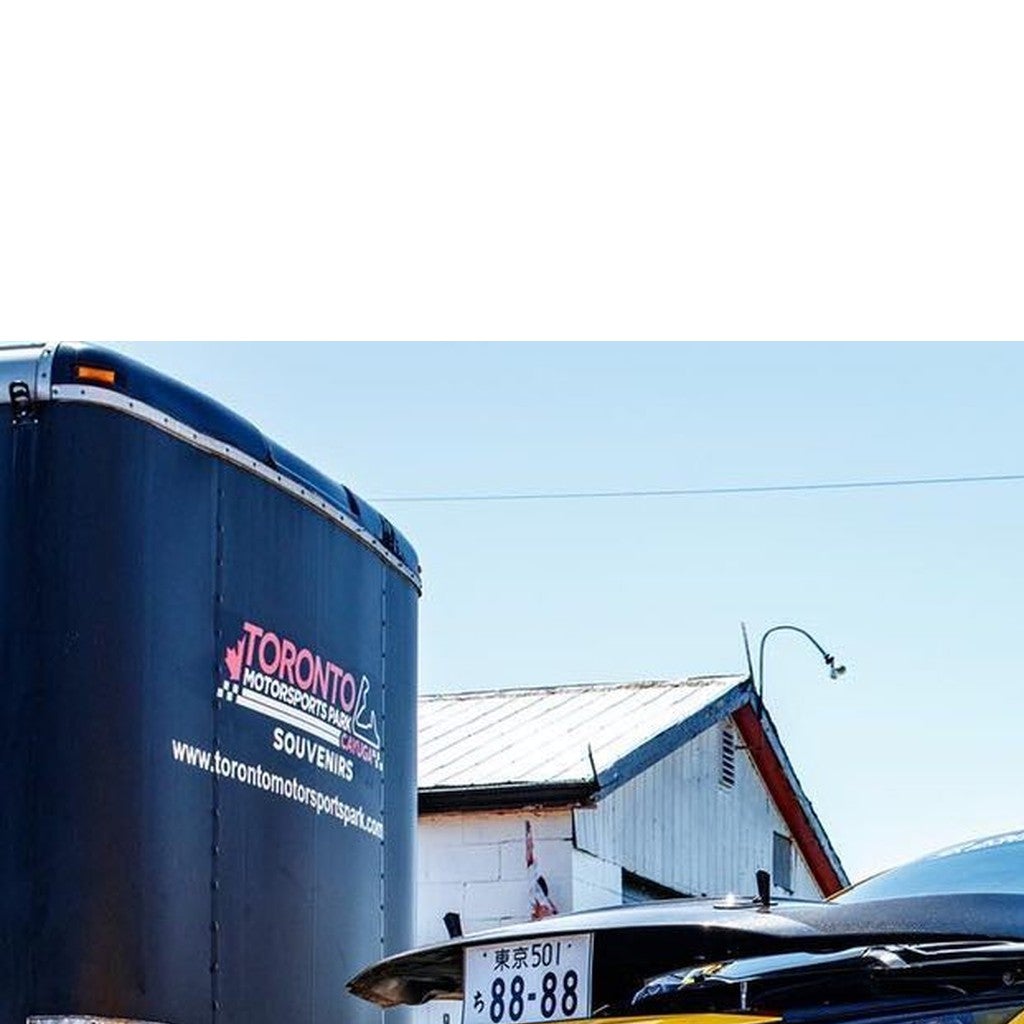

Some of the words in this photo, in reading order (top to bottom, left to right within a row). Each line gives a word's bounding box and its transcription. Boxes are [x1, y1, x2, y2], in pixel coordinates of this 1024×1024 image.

[243, 622, 356, 712] TORONTO
[243, 667, 328, 720] MOTORSPORTS
[328, 706, 354, 734] PARK
[273, 727, 354, 782] SOUVENIRS
[172, 739, 384, 839] www.torontomotorsportspark.com
[489, 969, 578, 1024] 88-88
